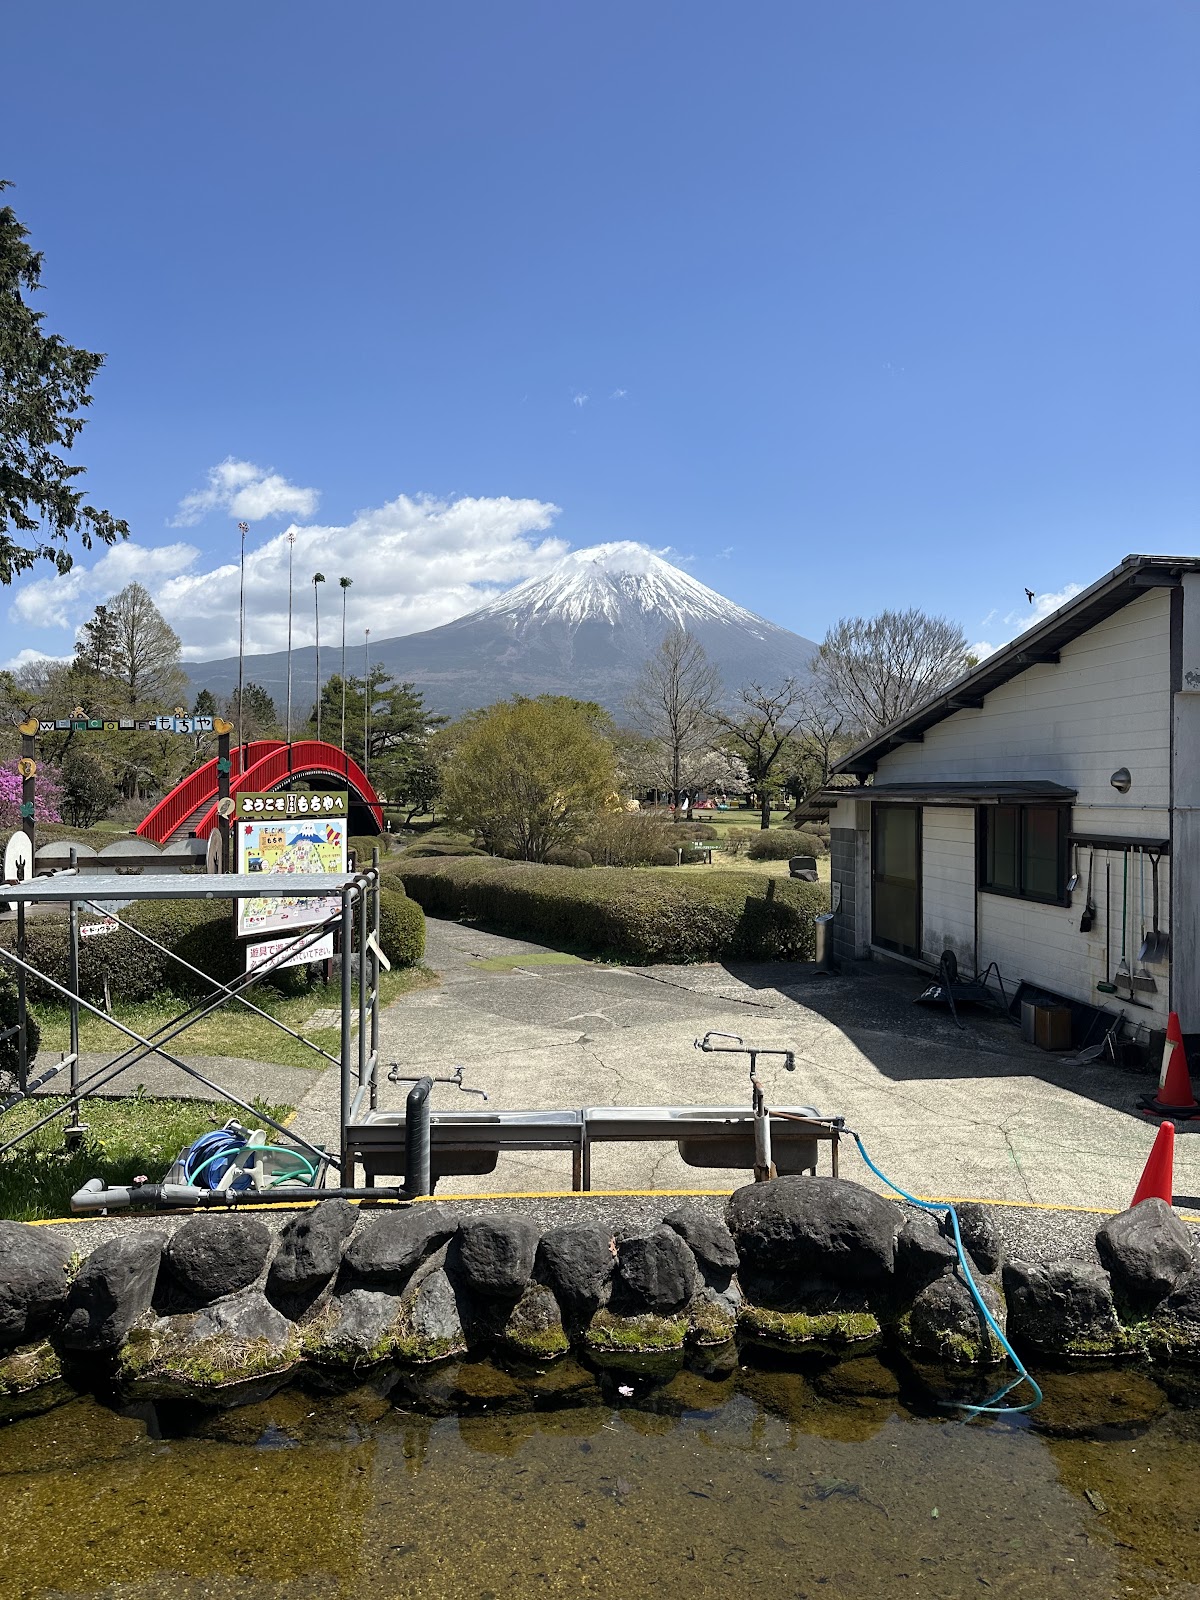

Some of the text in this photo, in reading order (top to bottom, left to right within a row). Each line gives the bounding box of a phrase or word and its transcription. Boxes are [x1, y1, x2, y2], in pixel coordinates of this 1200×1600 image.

[40, 719, 147, 731] WELCOME
[158, 716, 212, 733] もちや
[242, 797, 285, 812] ようこそ
[297, 795, 344, 813] もちやへ
